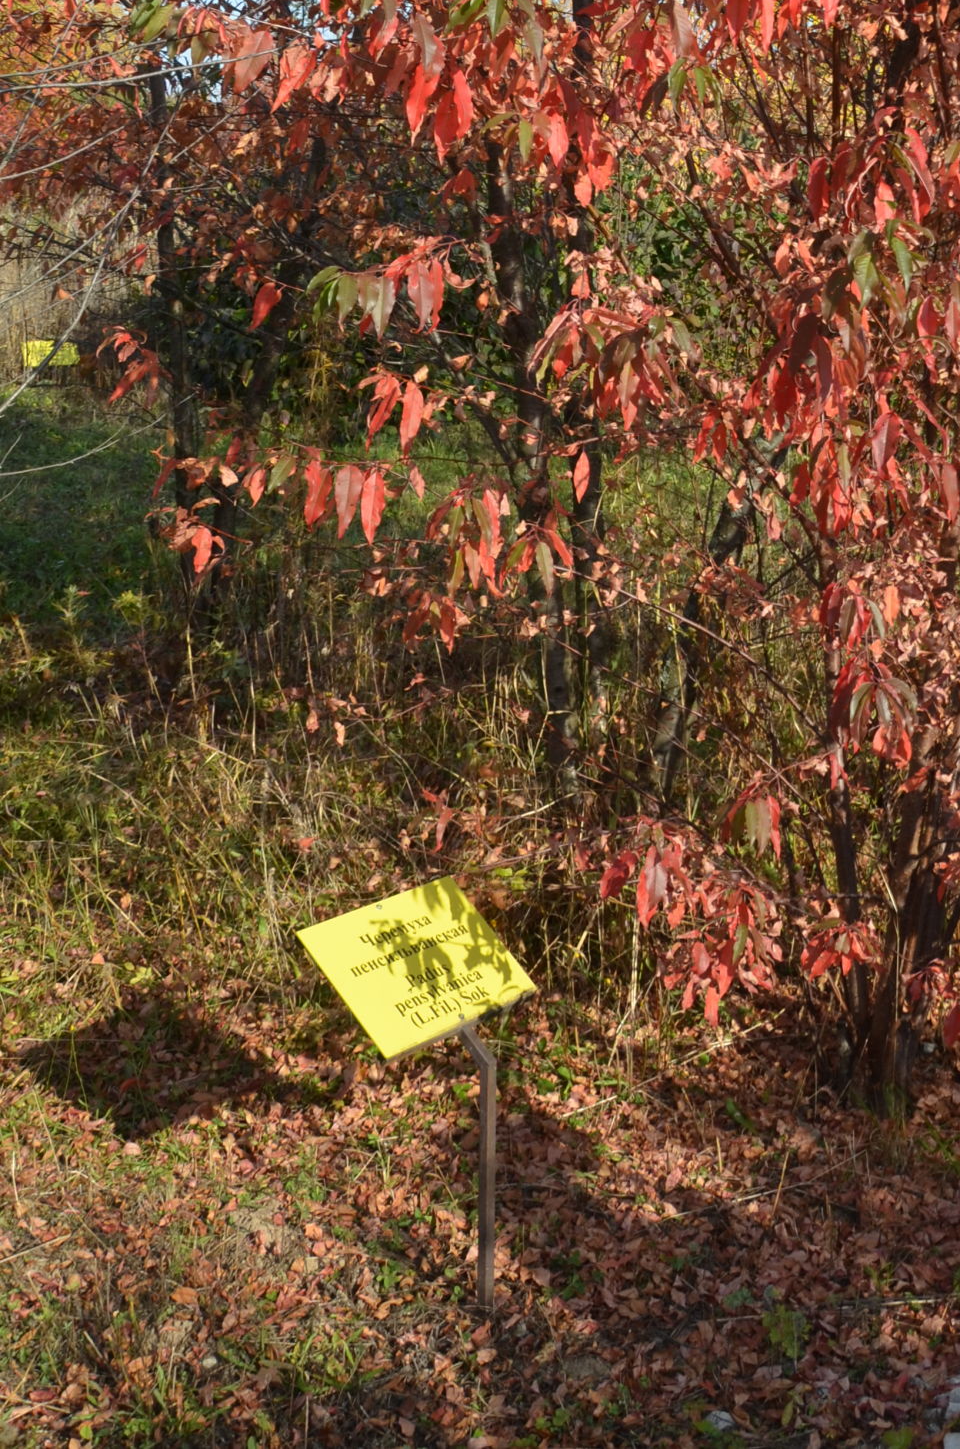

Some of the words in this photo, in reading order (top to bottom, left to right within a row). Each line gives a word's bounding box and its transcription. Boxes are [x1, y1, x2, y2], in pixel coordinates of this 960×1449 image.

[359, 914, 432, 947] Черемуха
[405, 963, 451, 988] Padus
[394, 969, 483, 1017] pensylvanica
